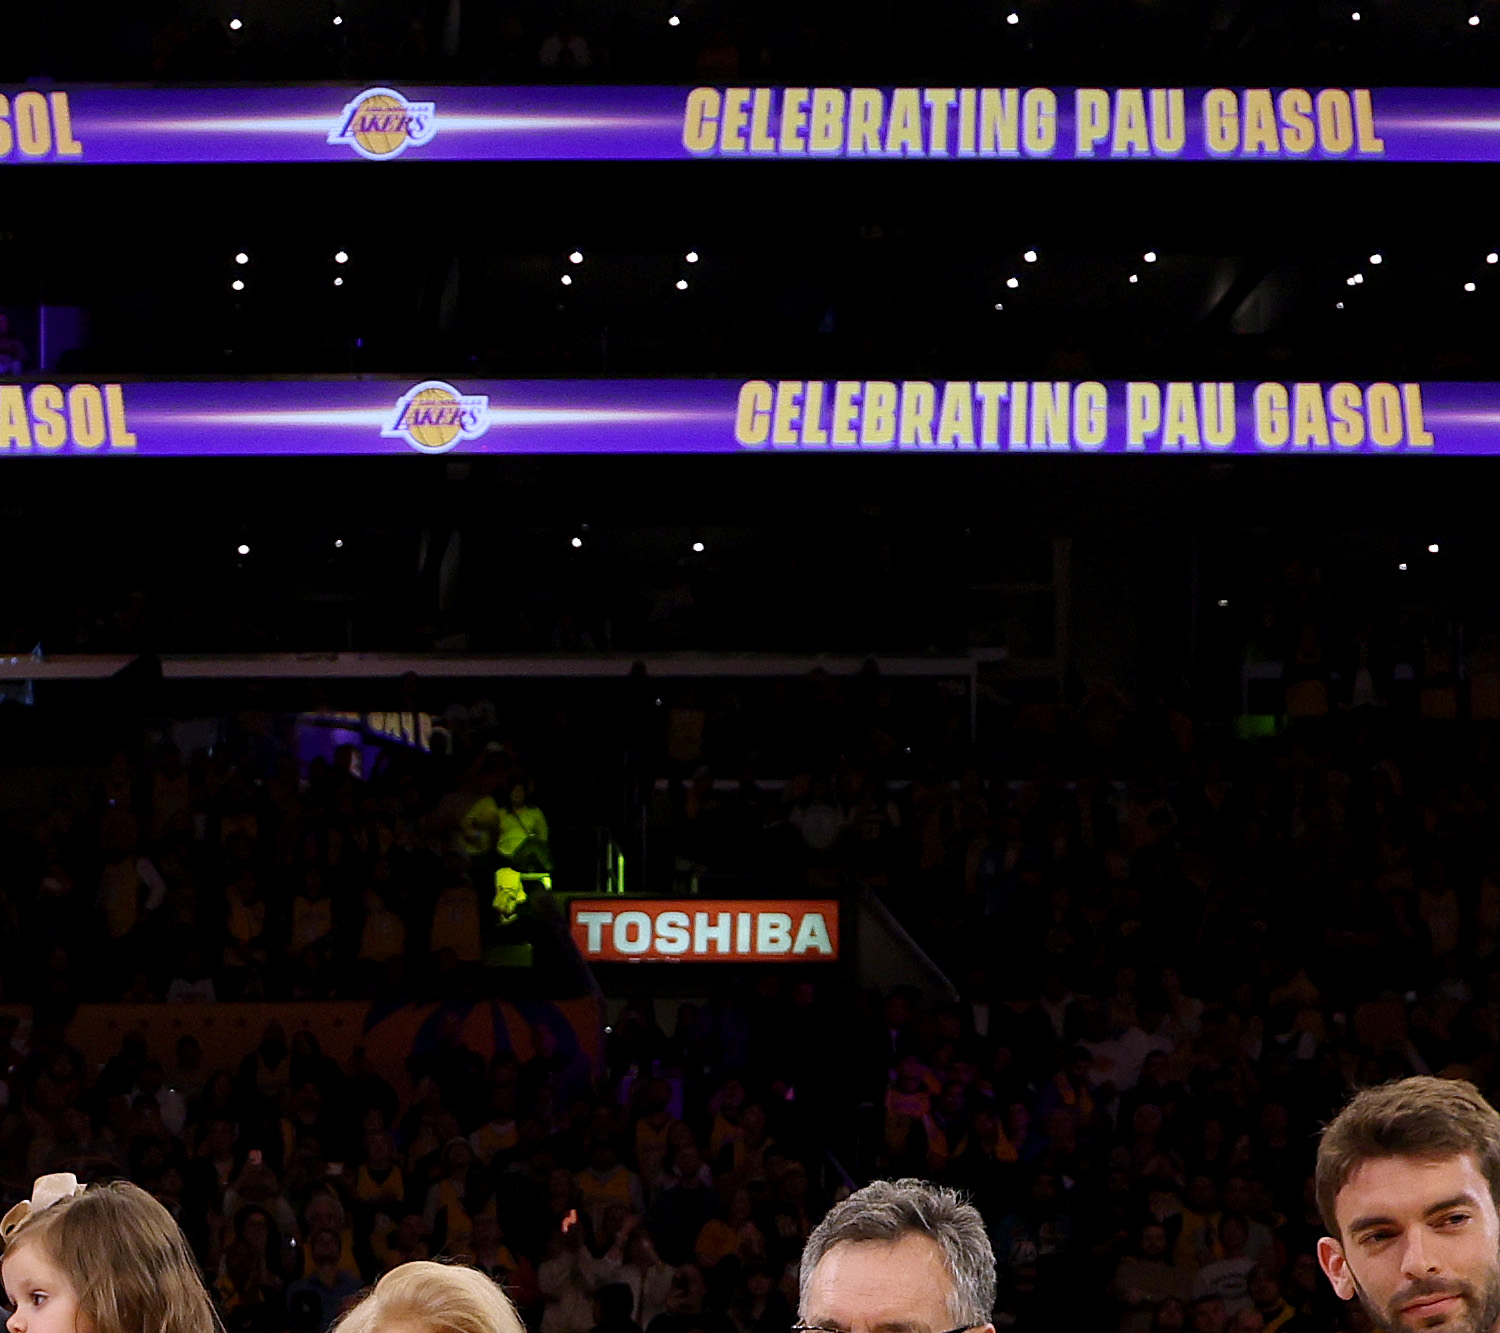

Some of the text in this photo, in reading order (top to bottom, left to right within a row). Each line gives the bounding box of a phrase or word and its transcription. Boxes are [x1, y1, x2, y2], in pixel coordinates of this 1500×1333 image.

[339, 106, 430, 140] LAKERS
[683, 85, 1386, 155] CELEBRATING PAU GASOL
[392, 399, 484, 433] LAKERS
[736, 379, 1435, 449] CELEBRATING PAU GASOL
[576, 910, 834, 956] TOSHIBA
